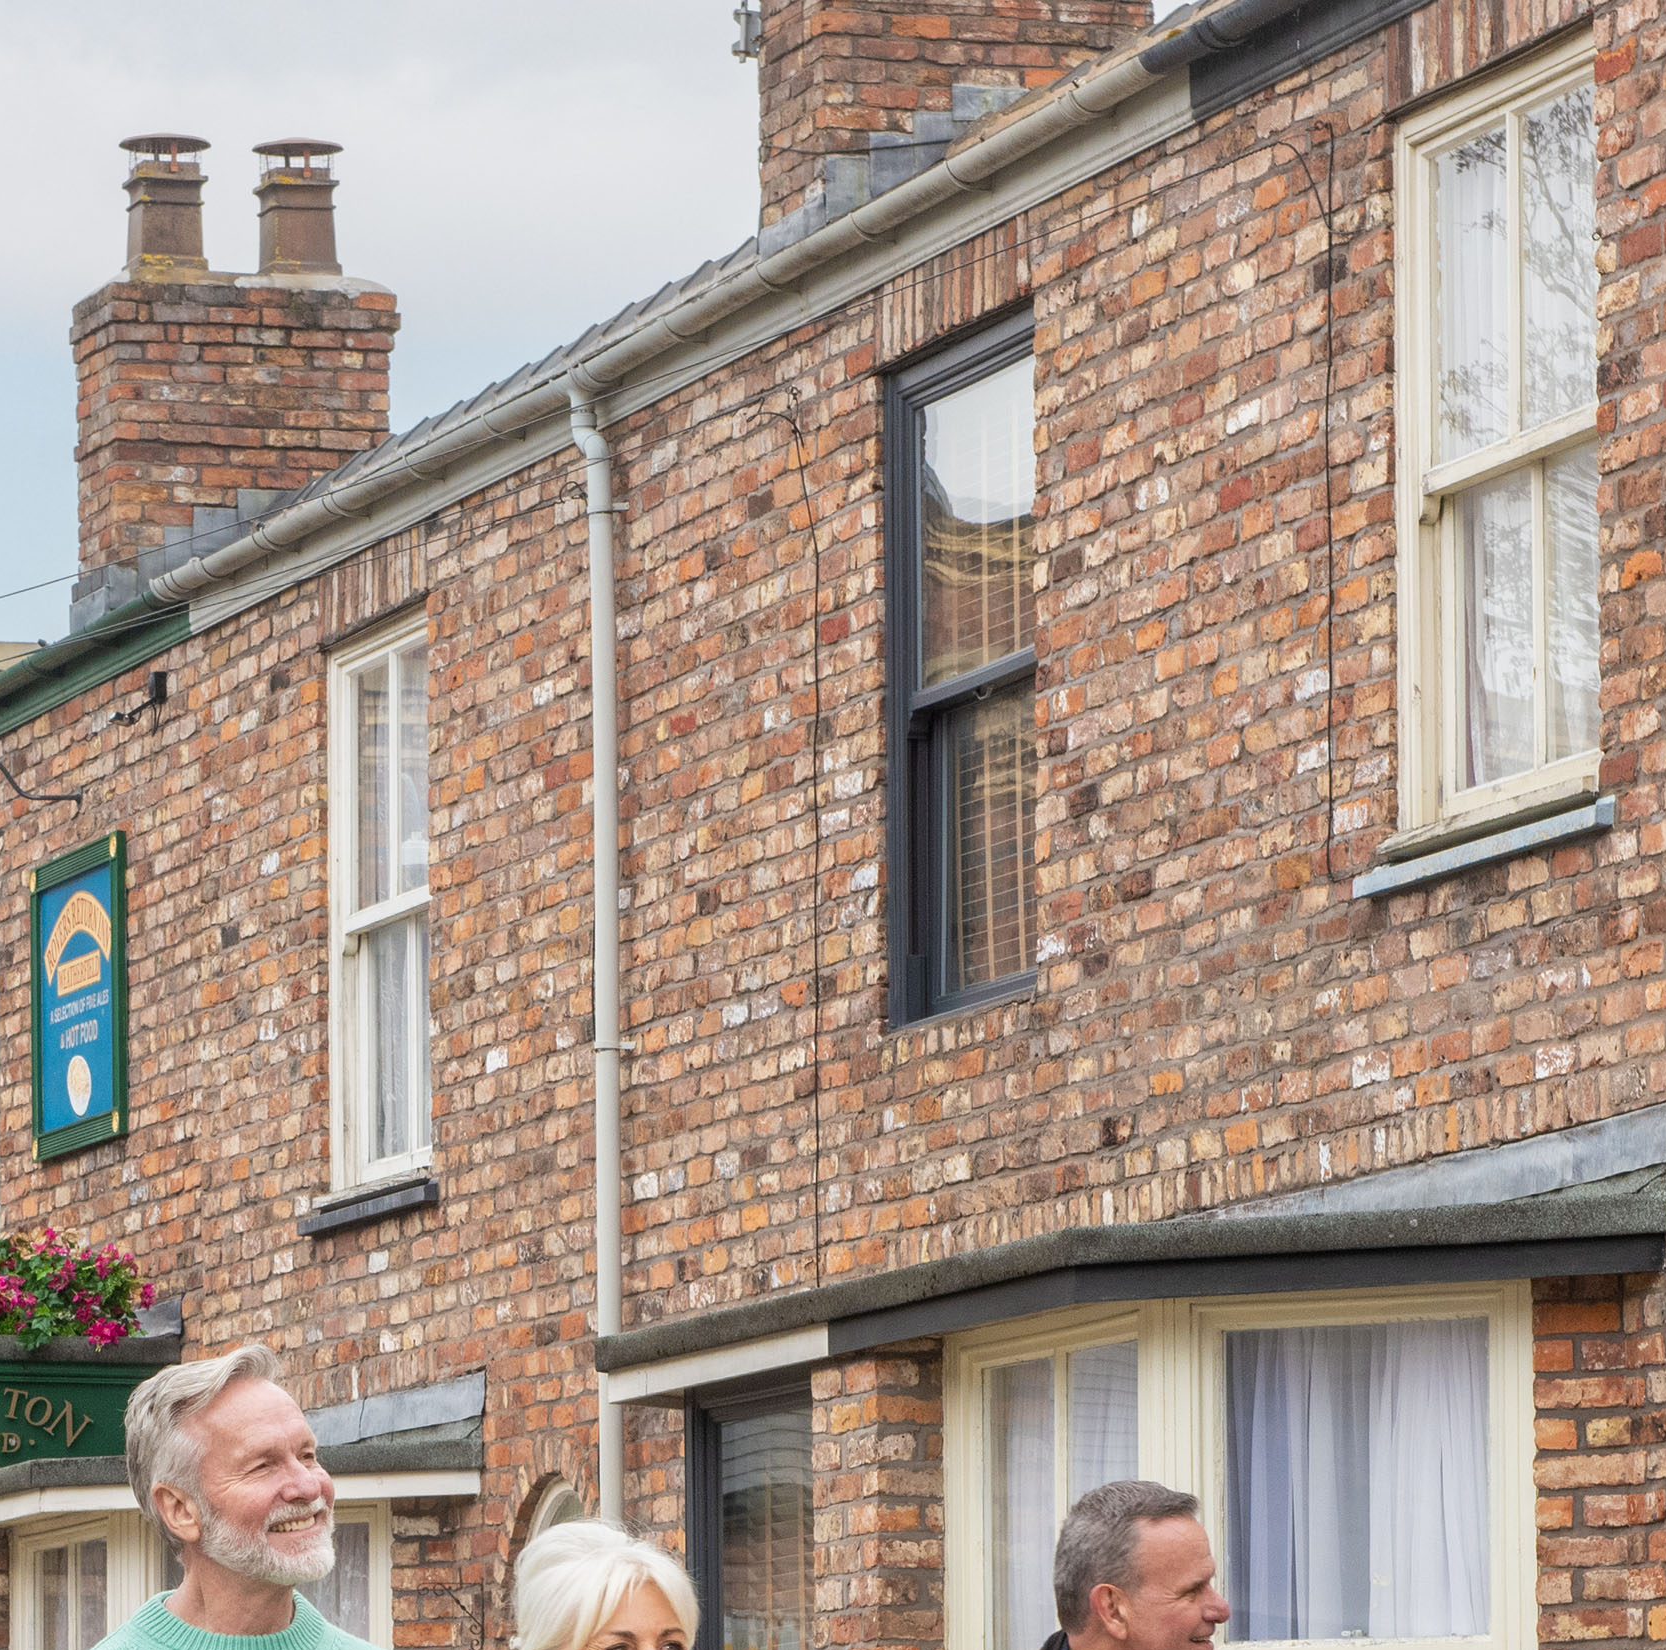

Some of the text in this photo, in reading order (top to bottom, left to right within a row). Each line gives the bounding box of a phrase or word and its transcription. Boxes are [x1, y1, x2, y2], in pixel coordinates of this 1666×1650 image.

[54, 1000, 79, 1024] SELECTION
[97, 988, 109, 1007] ALES
[65, 1024, 80, 1049] HOT
[80, 1019, 98, 1045] FOOD
